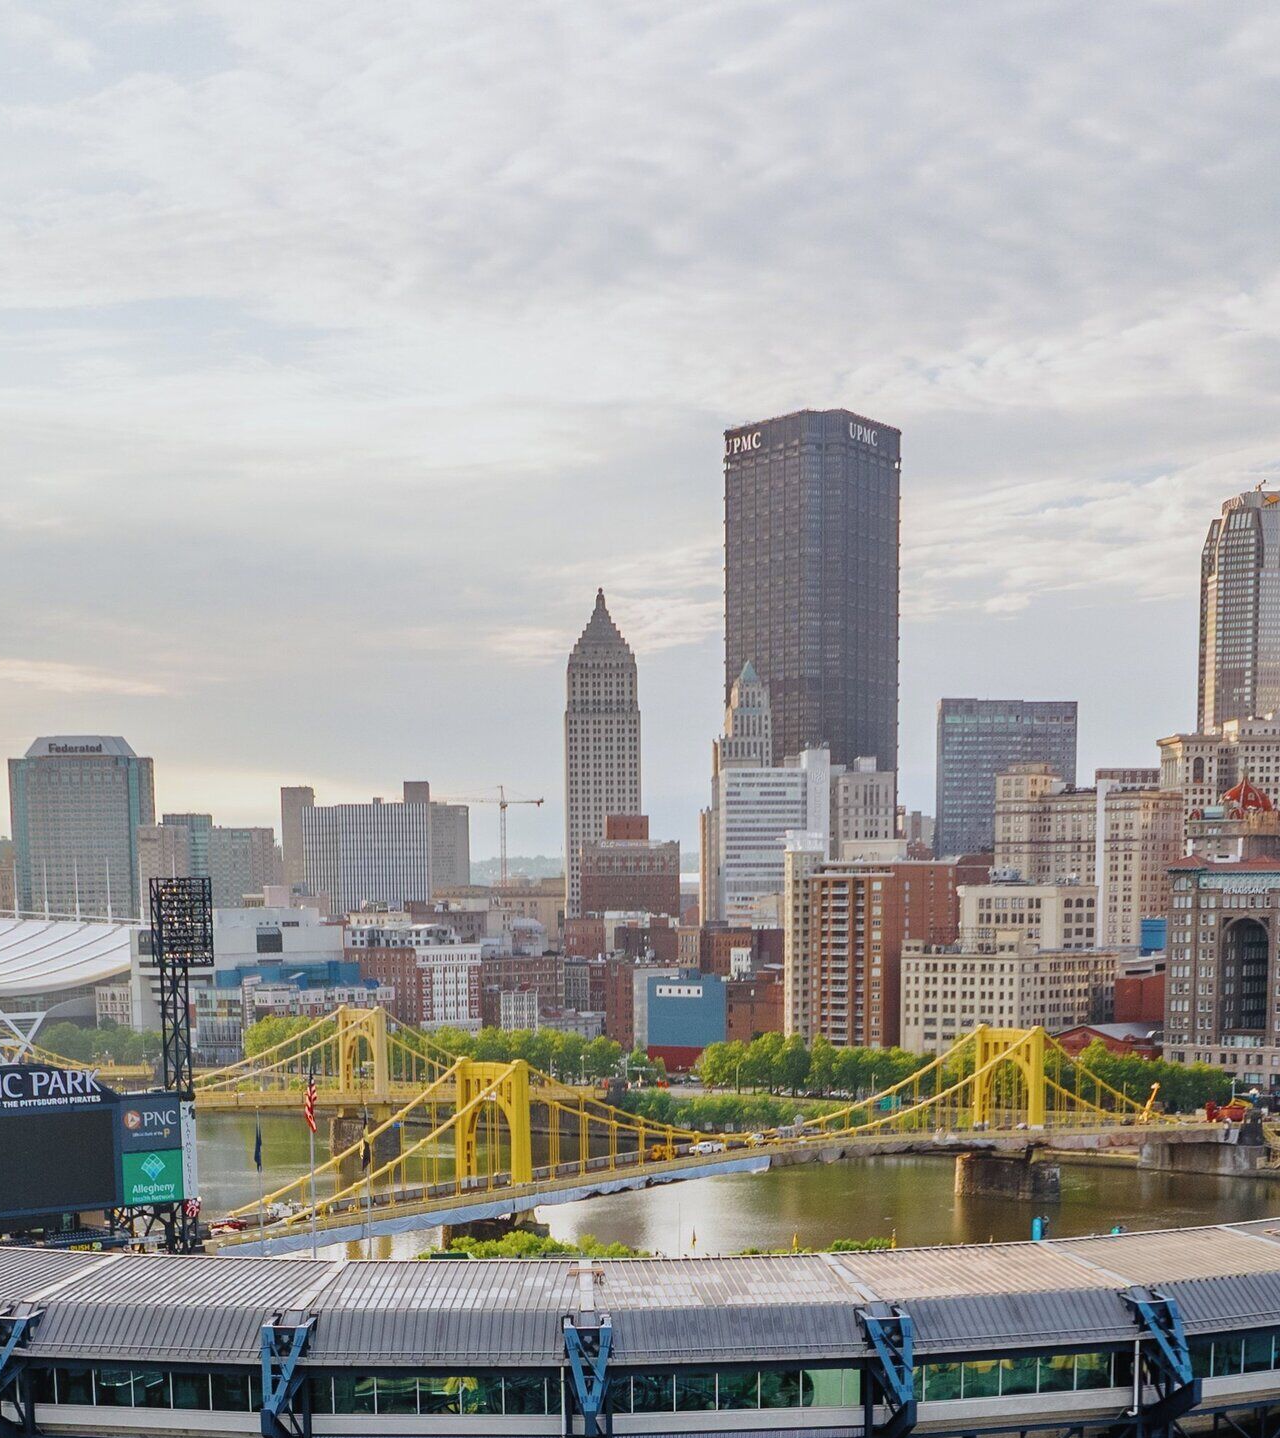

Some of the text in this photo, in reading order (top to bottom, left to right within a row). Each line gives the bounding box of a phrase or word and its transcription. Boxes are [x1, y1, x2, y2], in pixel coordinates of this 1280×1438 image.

[848, 422, 878, 447] UPMC
[724, 431, 761, 456] UPMC
[48, 743, 102, 753] Federated
[28, 1068, 101, 1096] PARK
[20, 1097, 68, 1107] PITTSBURGH
[70, 1095, 101, 1105] PIRATES
[143, 1110, 177, 1126] PNC
[132, 1183, 175, 1195] Allegheny
